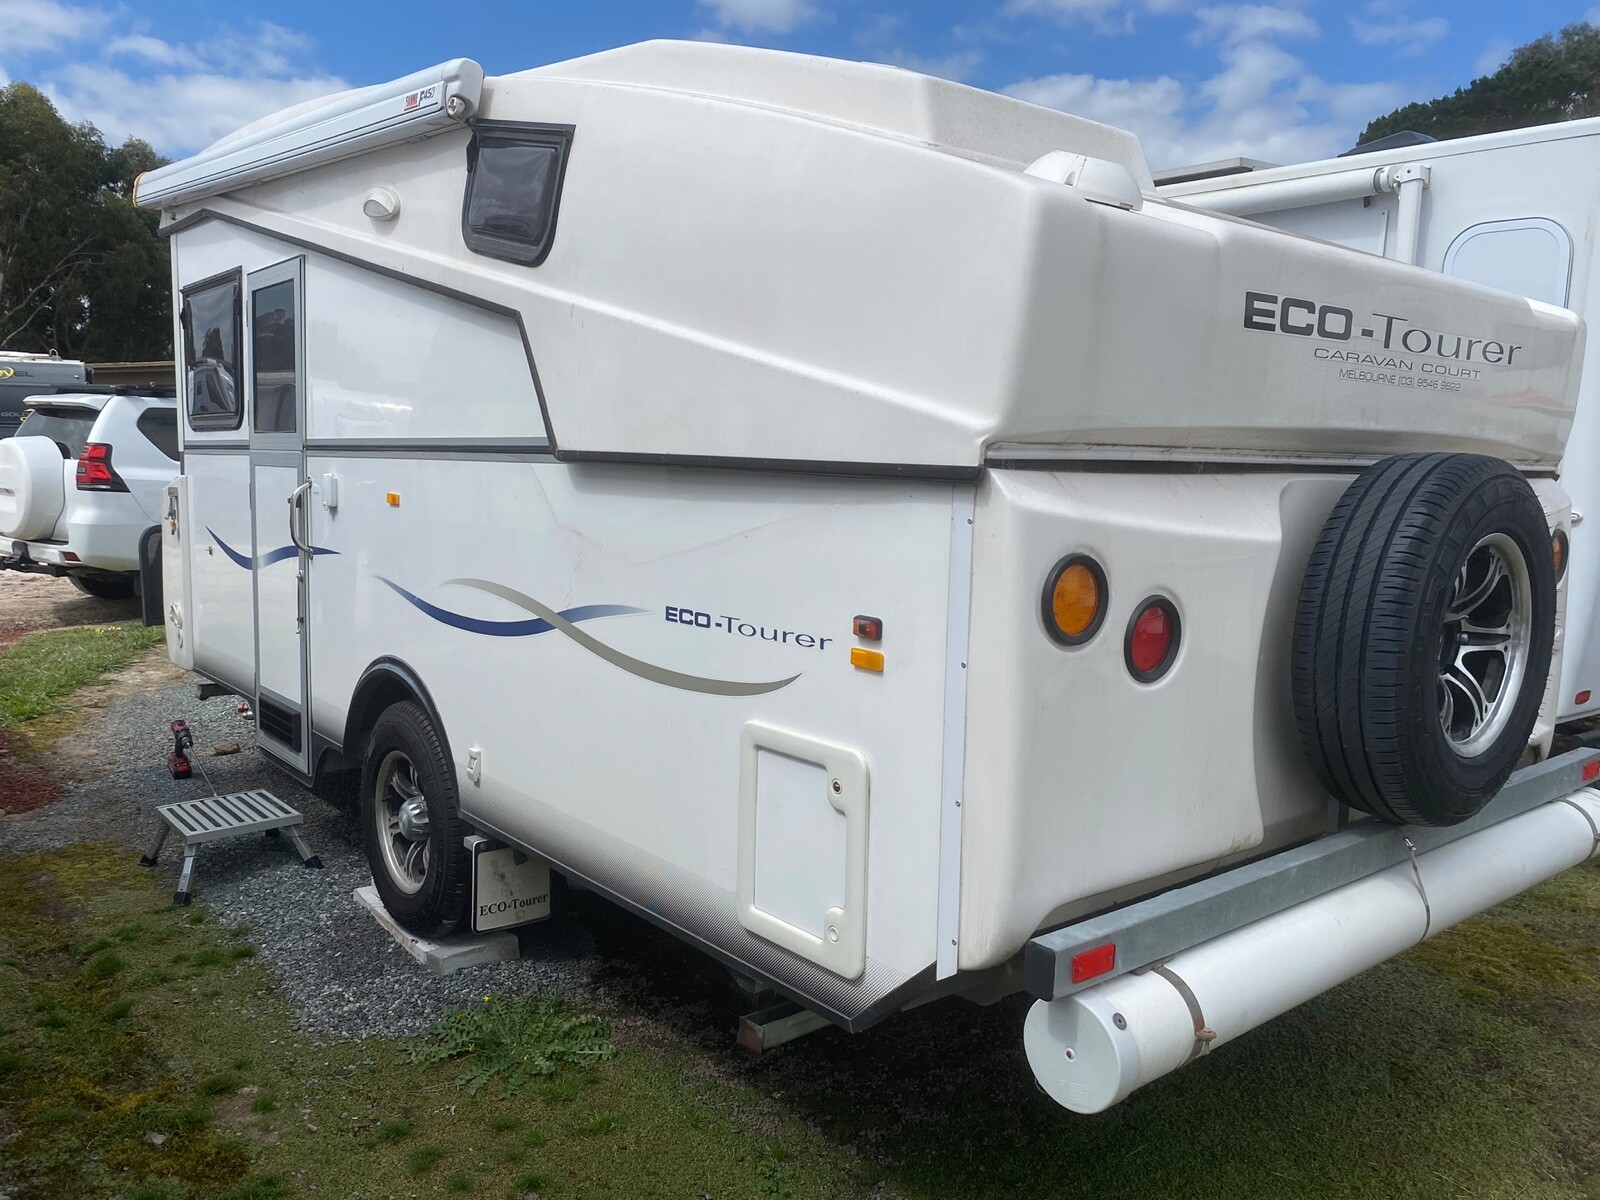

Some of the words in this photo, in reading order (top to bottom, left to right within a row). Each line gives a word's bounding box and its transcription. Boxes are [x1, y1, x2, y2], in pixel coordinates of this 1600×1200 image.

[1244, 291, 1522, 364] ECO-Tourer
[1314, 348, 1413, 371] CARAVAN
[1421, 363, 1481, 379] COURT
[1339, 369, 1396, 384] MELBOURNE
[1398, 376, 1415, 387] (03)
[1417, 379, 1438, 389] 9546
[665, 605, 833, 650] ECO-Tourer
[480, 894, 548, 916] ECO-Tourer
